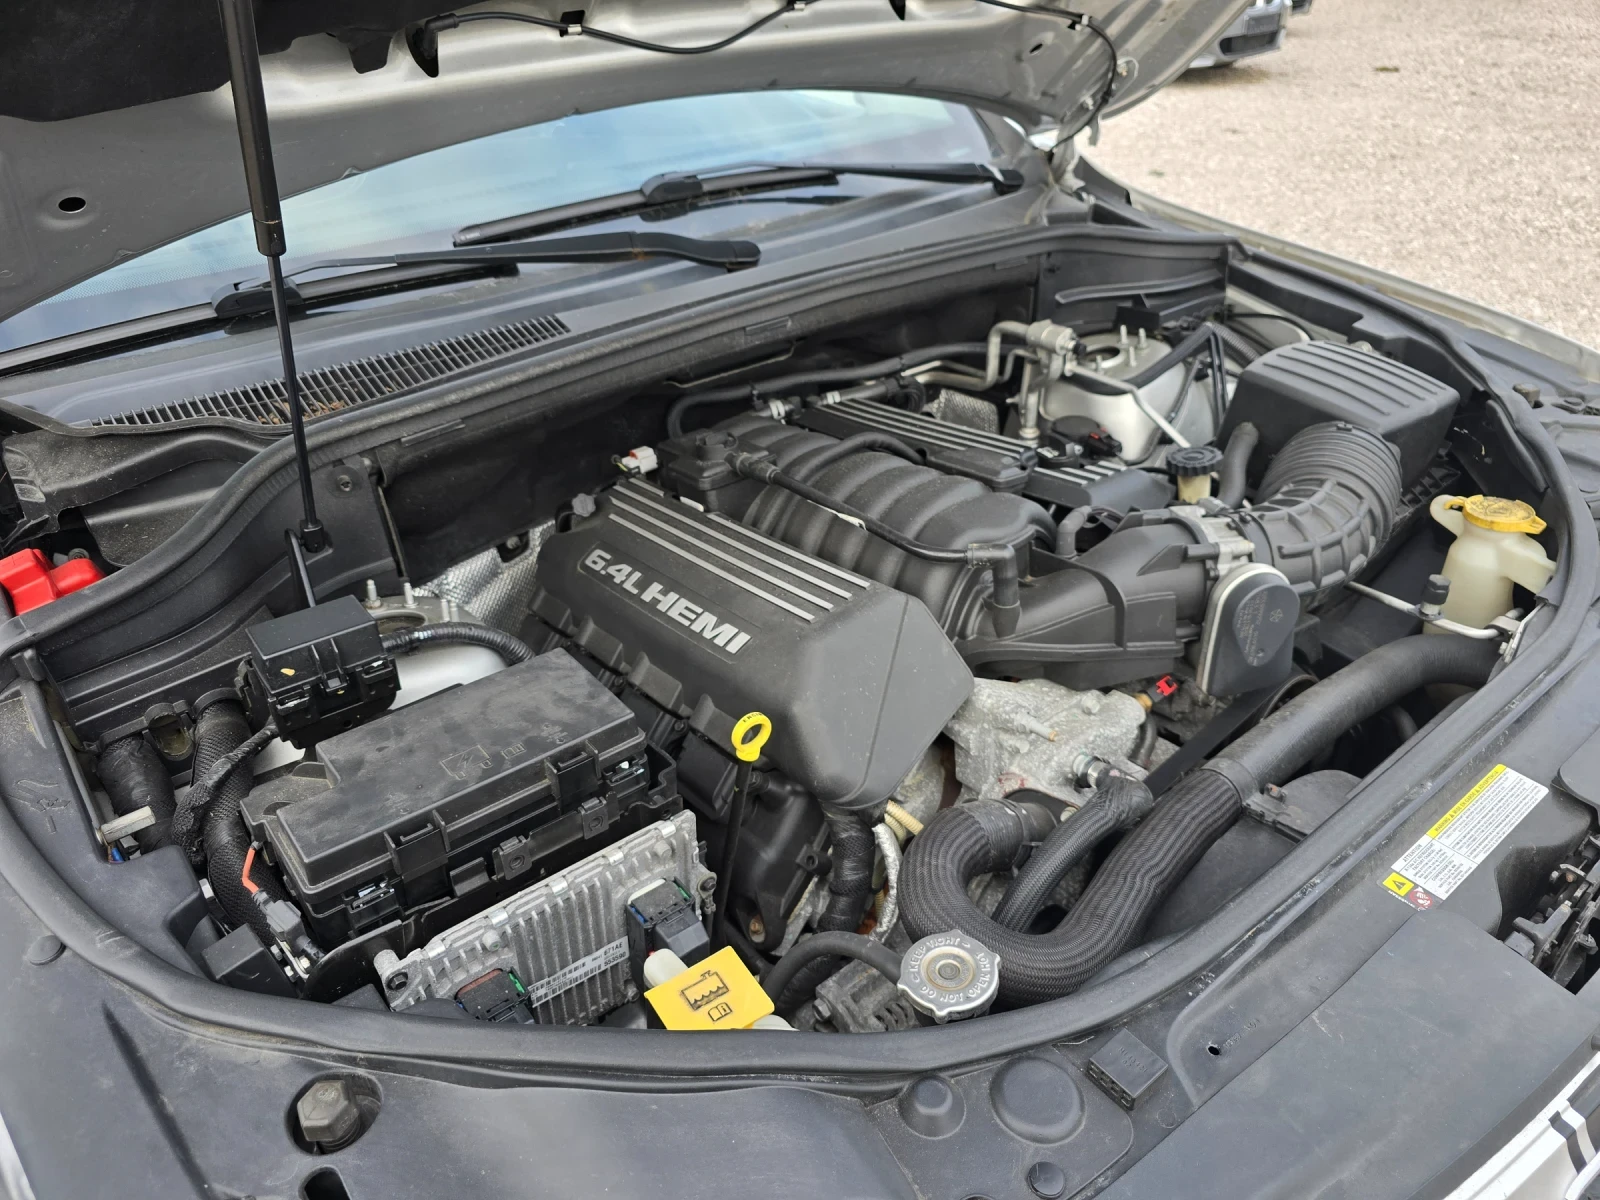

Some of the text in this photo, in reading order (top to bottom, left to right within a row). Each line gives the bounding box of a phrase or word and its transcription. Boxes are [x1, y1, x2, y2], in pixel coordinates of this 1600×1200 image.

[585, 549, 751, 654] 6.4L HEMI
[1401, 843, 1423, 862] ATTENTION
[909, 946, 926, 972] KEEP
[926, 937, 960, 948] TIGHT
[975, 952, 990, 971] HOT
[920, 986, 936, 998] DO
[968, 974, 990, 997] OPEN
[940, 993, 964, 1002] NOT
